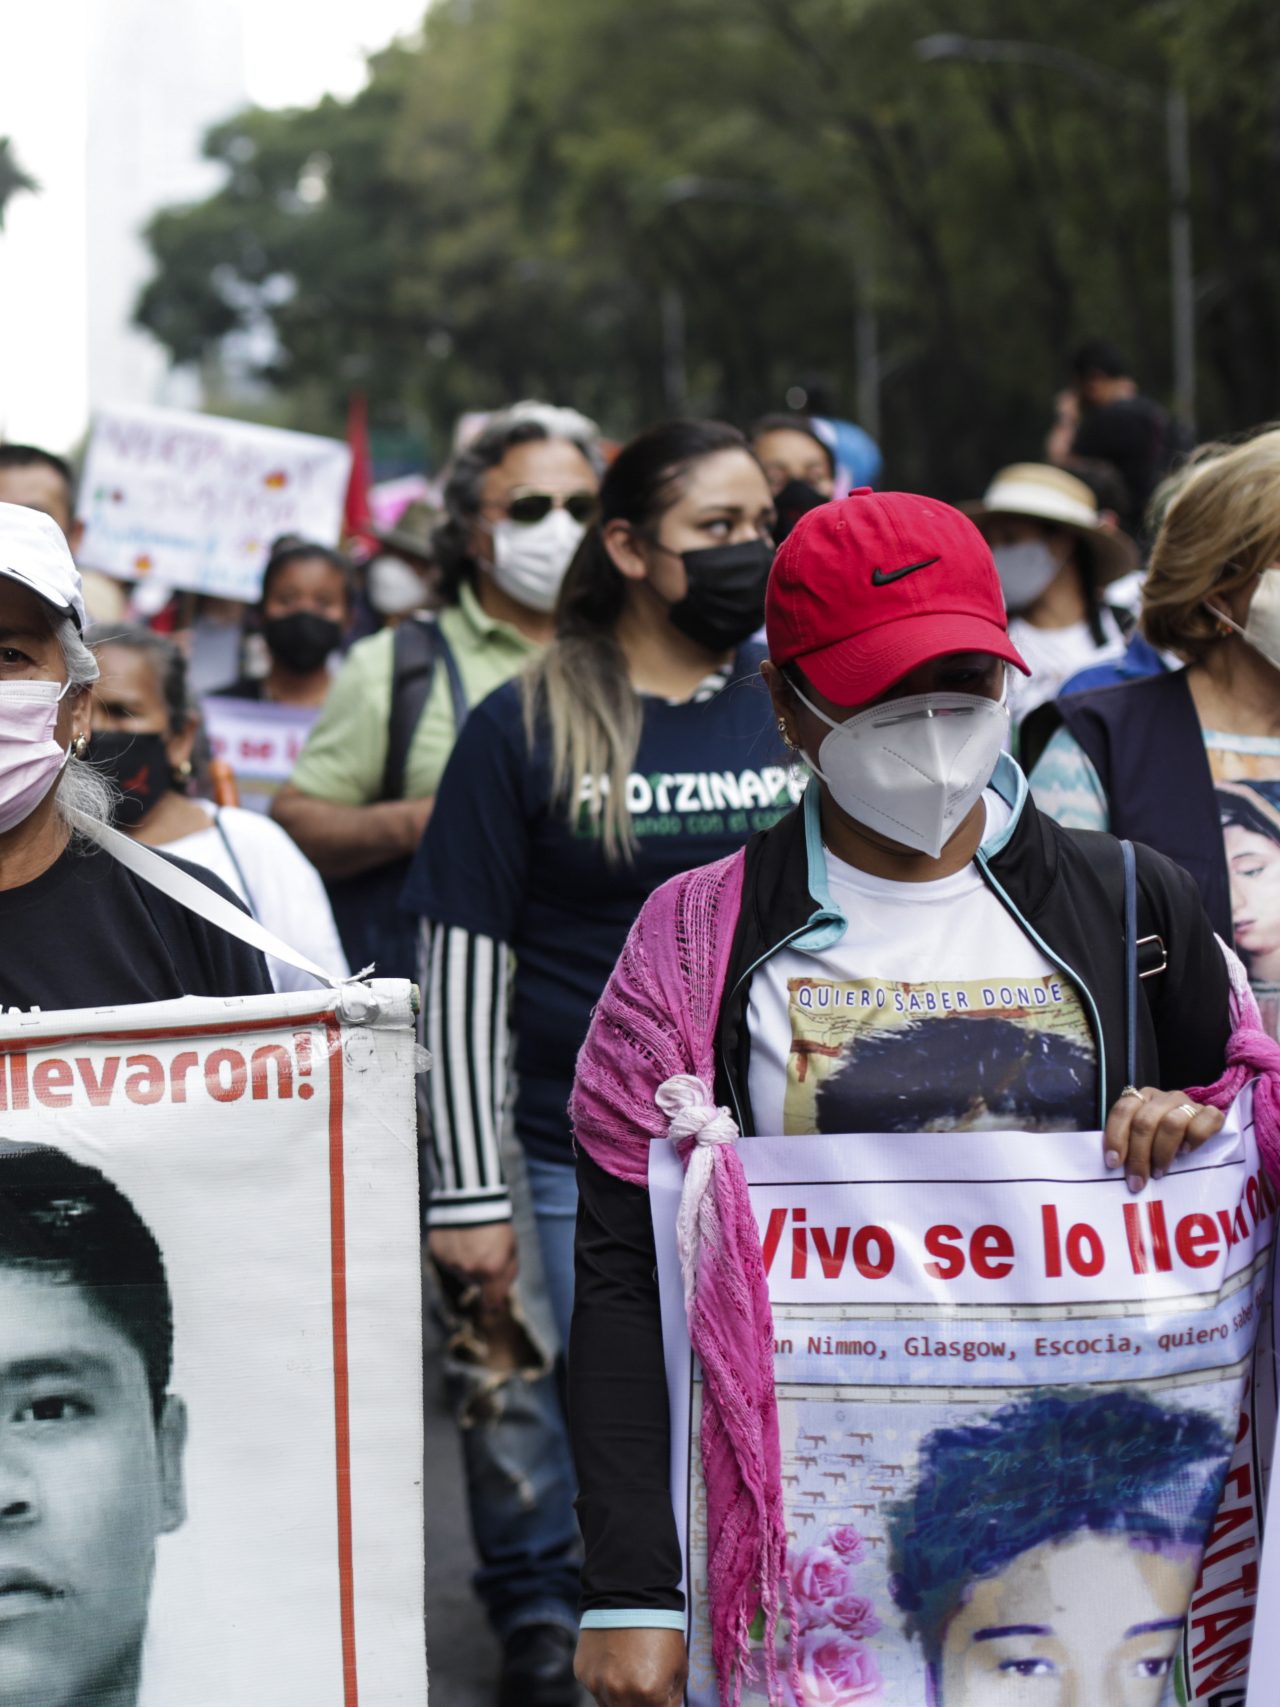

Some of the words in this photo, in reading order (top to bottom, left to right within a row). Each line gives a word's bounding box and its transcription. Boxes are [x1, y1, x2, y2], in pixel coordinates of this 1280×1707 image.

[799, 986, 886, 1008] QUIERO
[895, 990, 969, 1012] SABER
[982, 983, 1062, 1006] DONDE
[922, 1224, 1015, 1280] se
[1040, 1203, 1106, 1279] lo
[808, 1335, 888, 1360] Nimmo,
[903, 1336, 1018, 1362] Glasgow,
[1034, 1333, 1143, 1356] Escocia,
[1157, 1323, 1229, 1352] quiero
